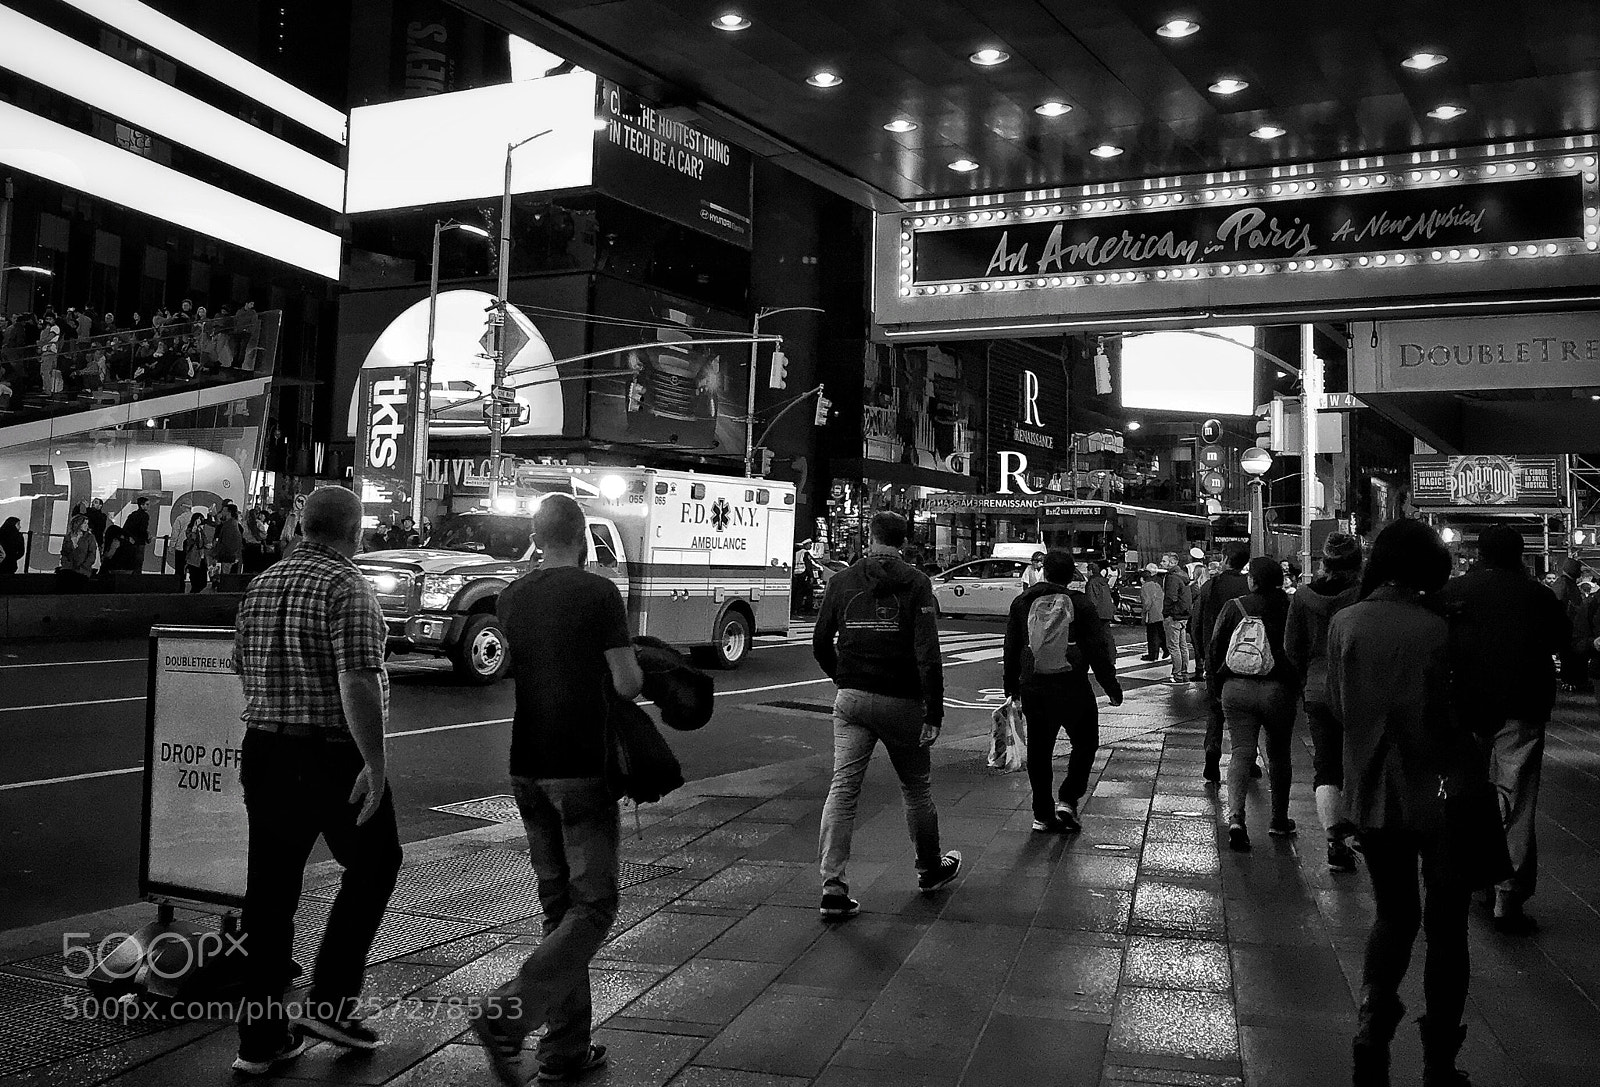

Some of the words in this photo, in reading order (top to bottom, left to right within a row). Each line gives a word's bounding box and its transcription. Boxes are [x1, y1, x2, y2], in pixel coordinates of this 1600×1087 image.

[609, 118, 621, 145] IN
[624, 124, 650, 158] TECH
[653, 138, 667, 165] BE
[668, 146, 676, 170] A
[678, 150, 704, 181] CAR?
[703, 134, 730, 166] THING
[984, 230, 1029, 277] An
[1037, 221, 1200, 275] American
[1202, 240, 1225, 257] in
[1216, 206, 1318, 258] Paris
[1331, 219, 1356, 242] A
[1355, 210, 1412, 242] New
[1402, 204, 1486, 242] Musical
[1024, 370, 1046, 427] R
[1329, 394, 1340, 407] W
[370, 375, 407, 468] tkts
[1013, 428, 1053, 450] RENAISSANCE
[425, 458, 475, 486] OLIVE
[996, 451, 1042, 495] R
[1450, 466, 1518, 500] PARAMOUR
[628, 494, 644, 504] 065
[654, 496, 666, 505] 065
[691, 536, 748, 551] AMBULANCE
[165, 655, 217, 668] DOUBLETREE
[161, 742, 206, 765] DROP
[211, 747, 242, 769] OFF
[177, 768, 222, 792] ZONE
